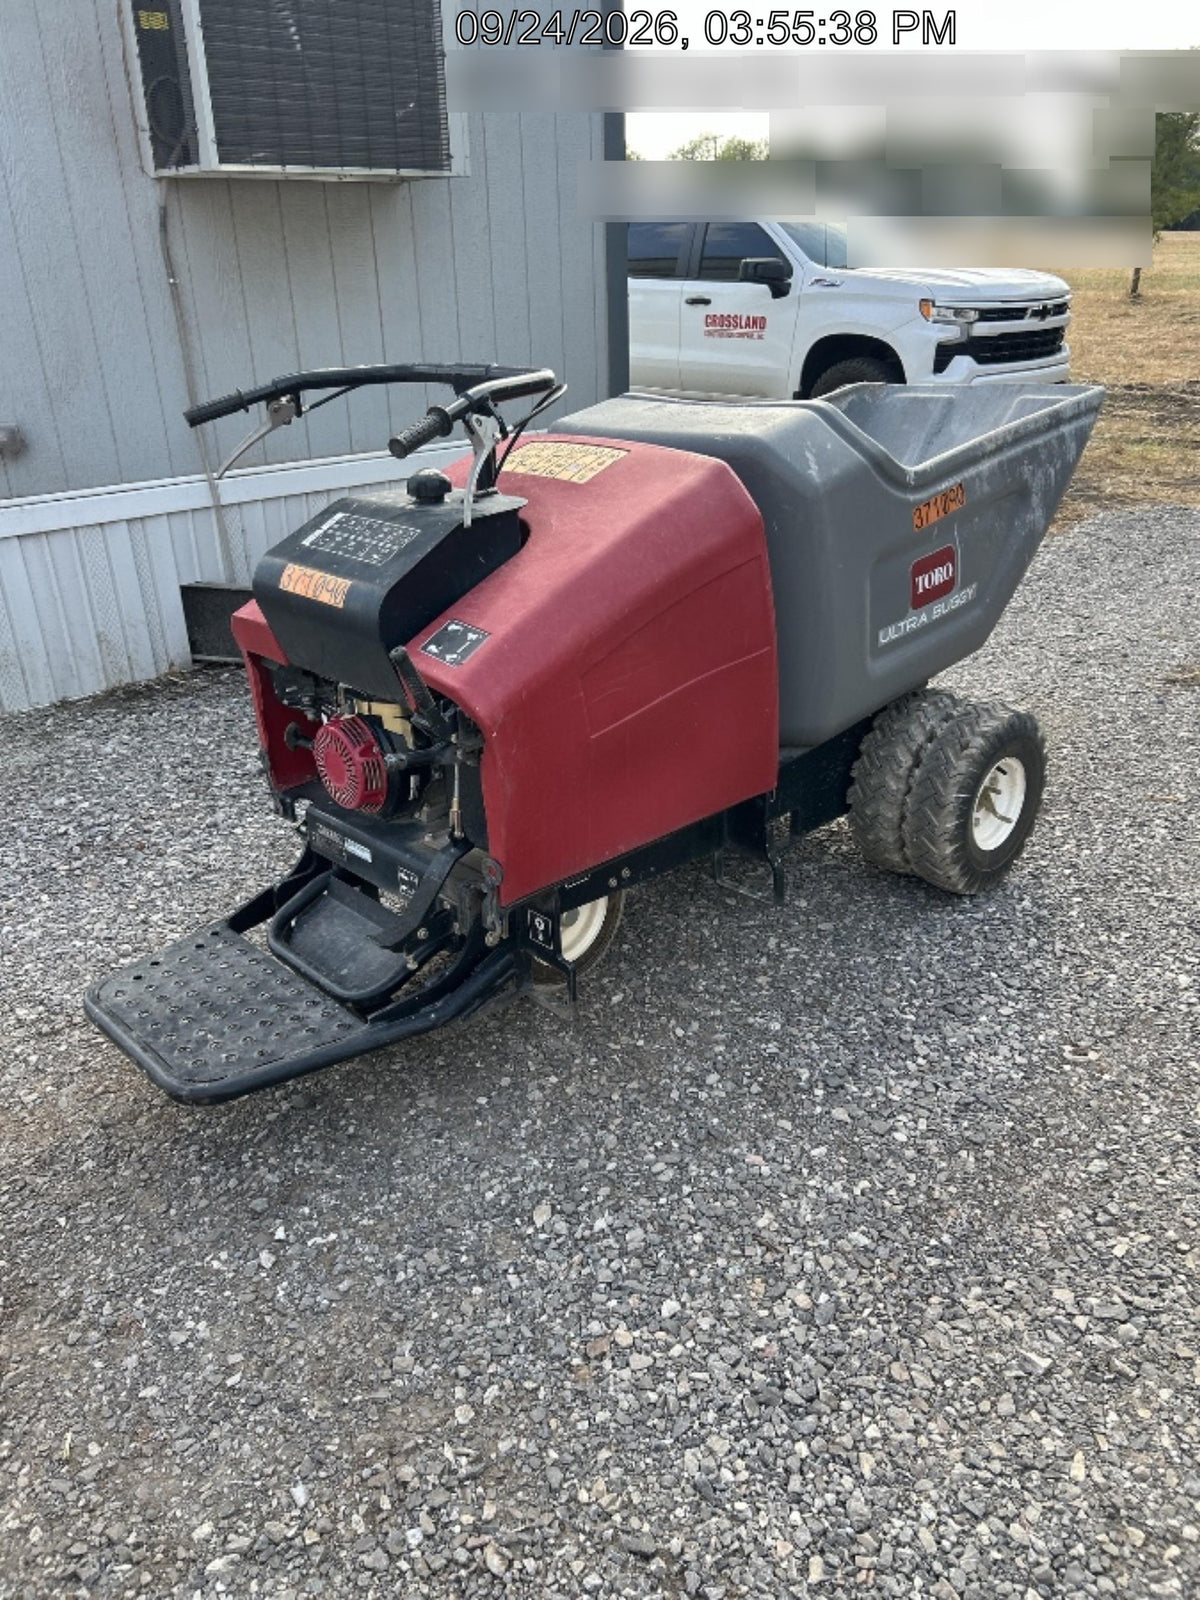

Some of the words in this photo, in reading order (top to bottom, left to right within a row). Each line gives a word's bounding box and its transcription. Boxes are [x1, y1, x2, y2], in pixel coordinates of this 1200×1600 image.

[704, 314, 767, 329] CROSSLAND
[913, 483, 965, 529] 371090
[915, 562, 953, 594] TORO
[879, 613, 927, 645] ULTRA
[932, 583, 977, 619] BUGGY
